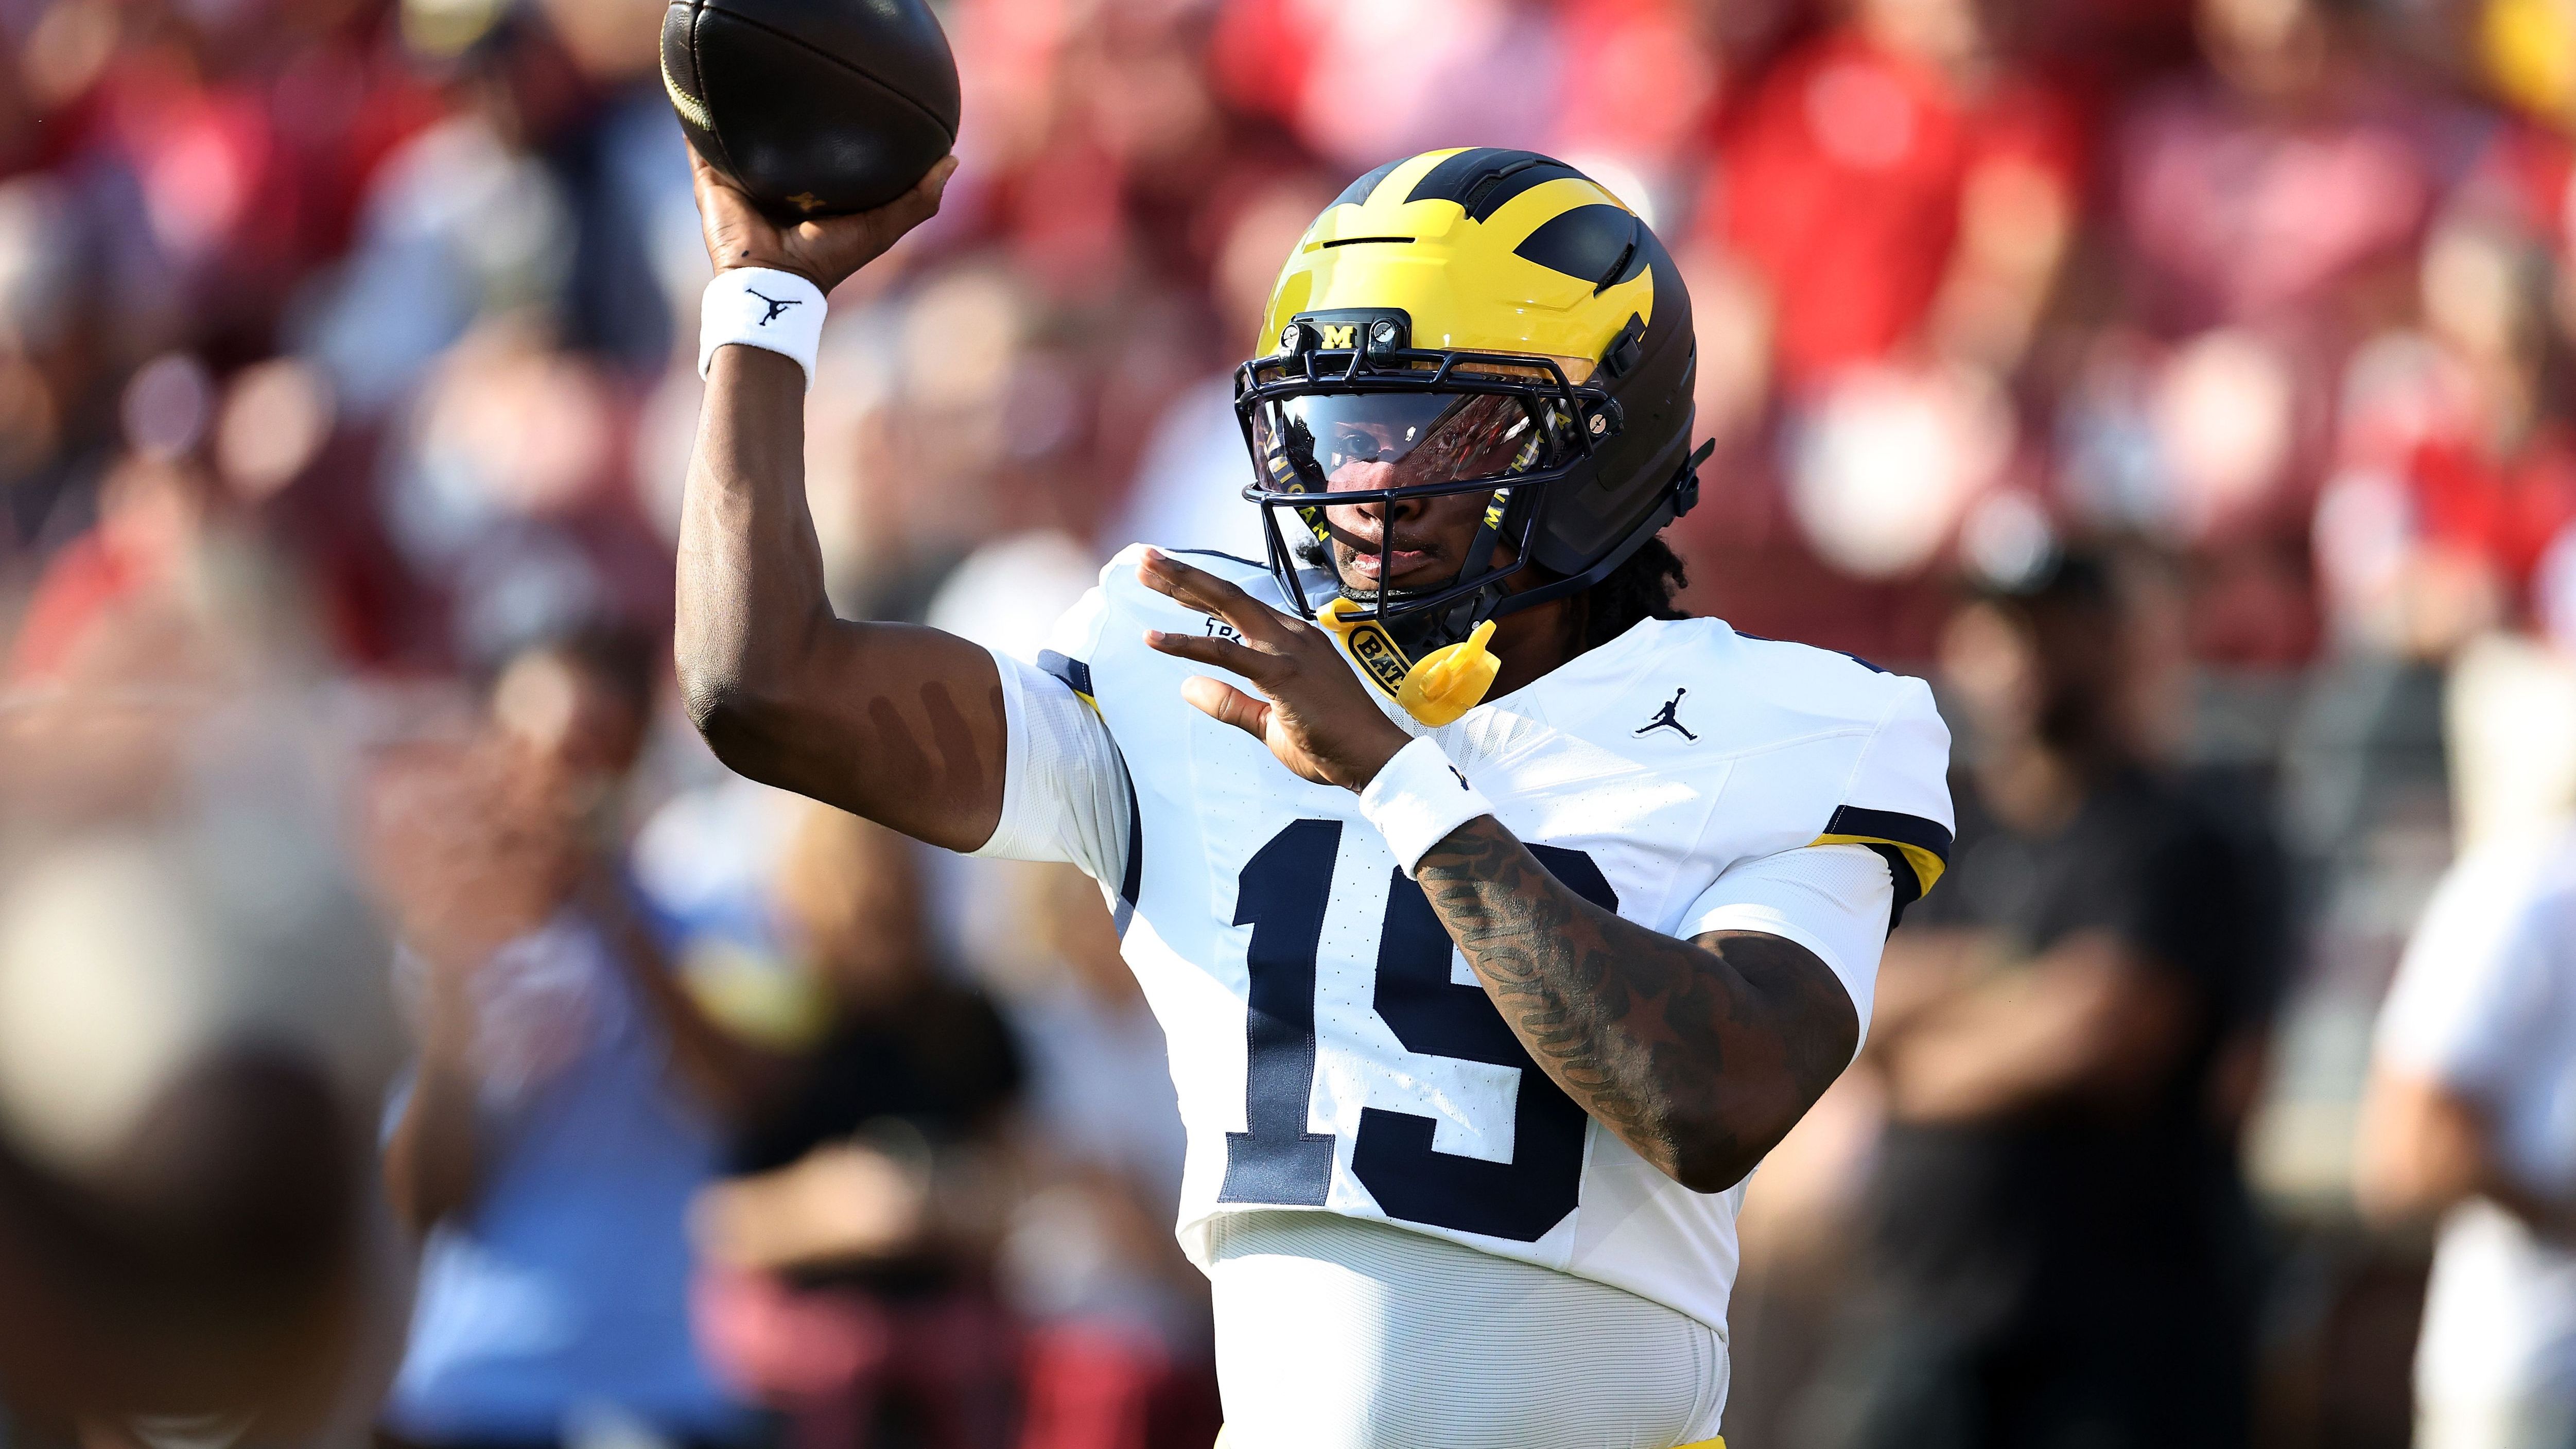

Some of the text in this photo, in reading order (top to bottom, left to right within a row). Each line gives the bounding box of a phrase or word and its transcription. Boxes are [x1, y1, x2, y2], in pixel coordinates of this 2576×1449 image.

[1321, 325, 1354, 349] M
[1484, 412, 1572, 531] MIHIA
[1356, 635, 1406, 691] BAT
[1217, 818, 1620, 1243] 19
